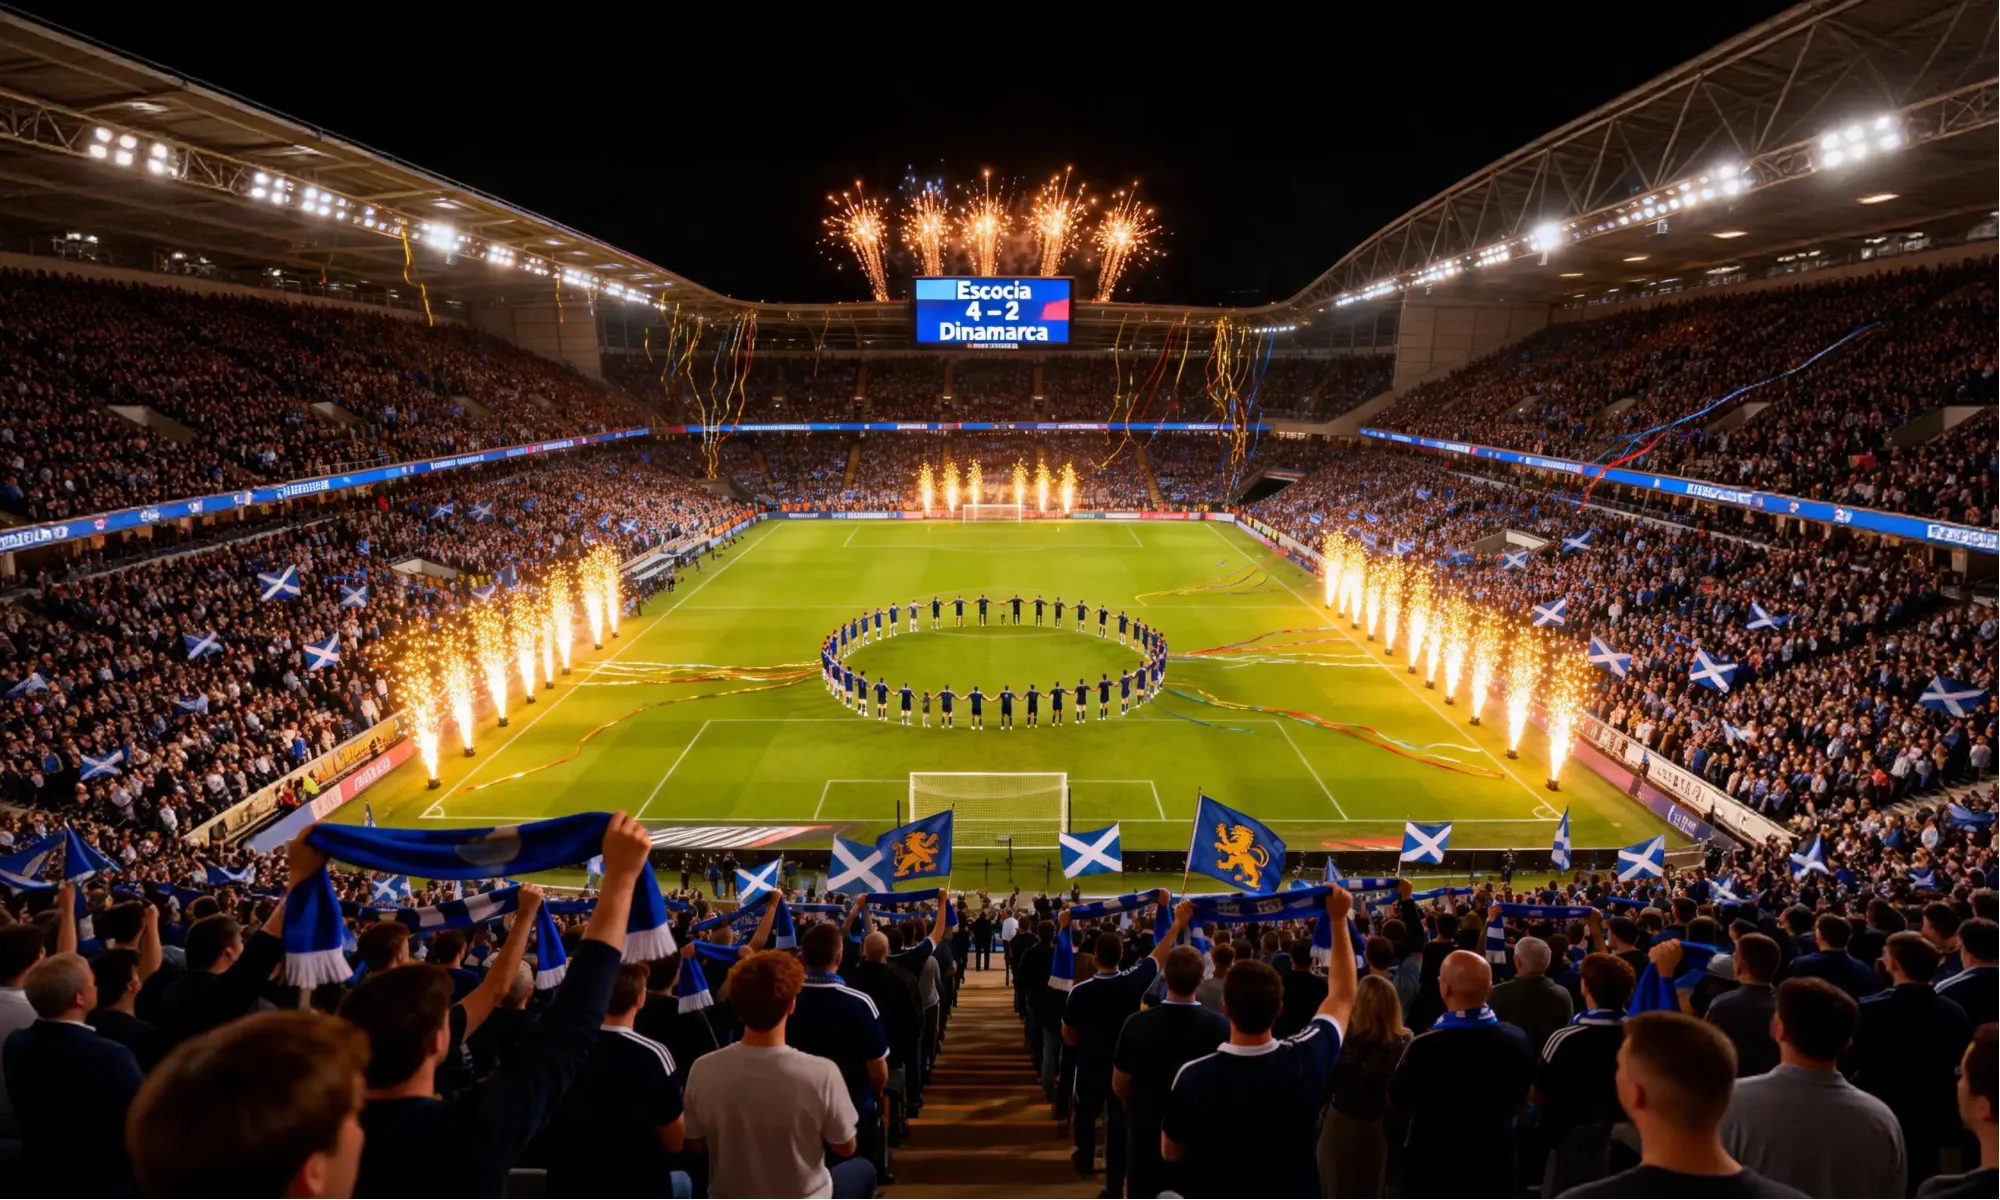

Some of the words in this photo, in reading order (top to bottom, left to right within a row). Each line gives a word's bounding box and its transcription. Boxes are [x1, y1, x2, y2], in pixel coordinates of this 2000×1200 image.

[957, 280, 1032, 300] Escocia
[965, 301, 982, 321] 4
[1005, 301, 1019, 321] 2
[939, 322, 1049, 341] Dinamarca
